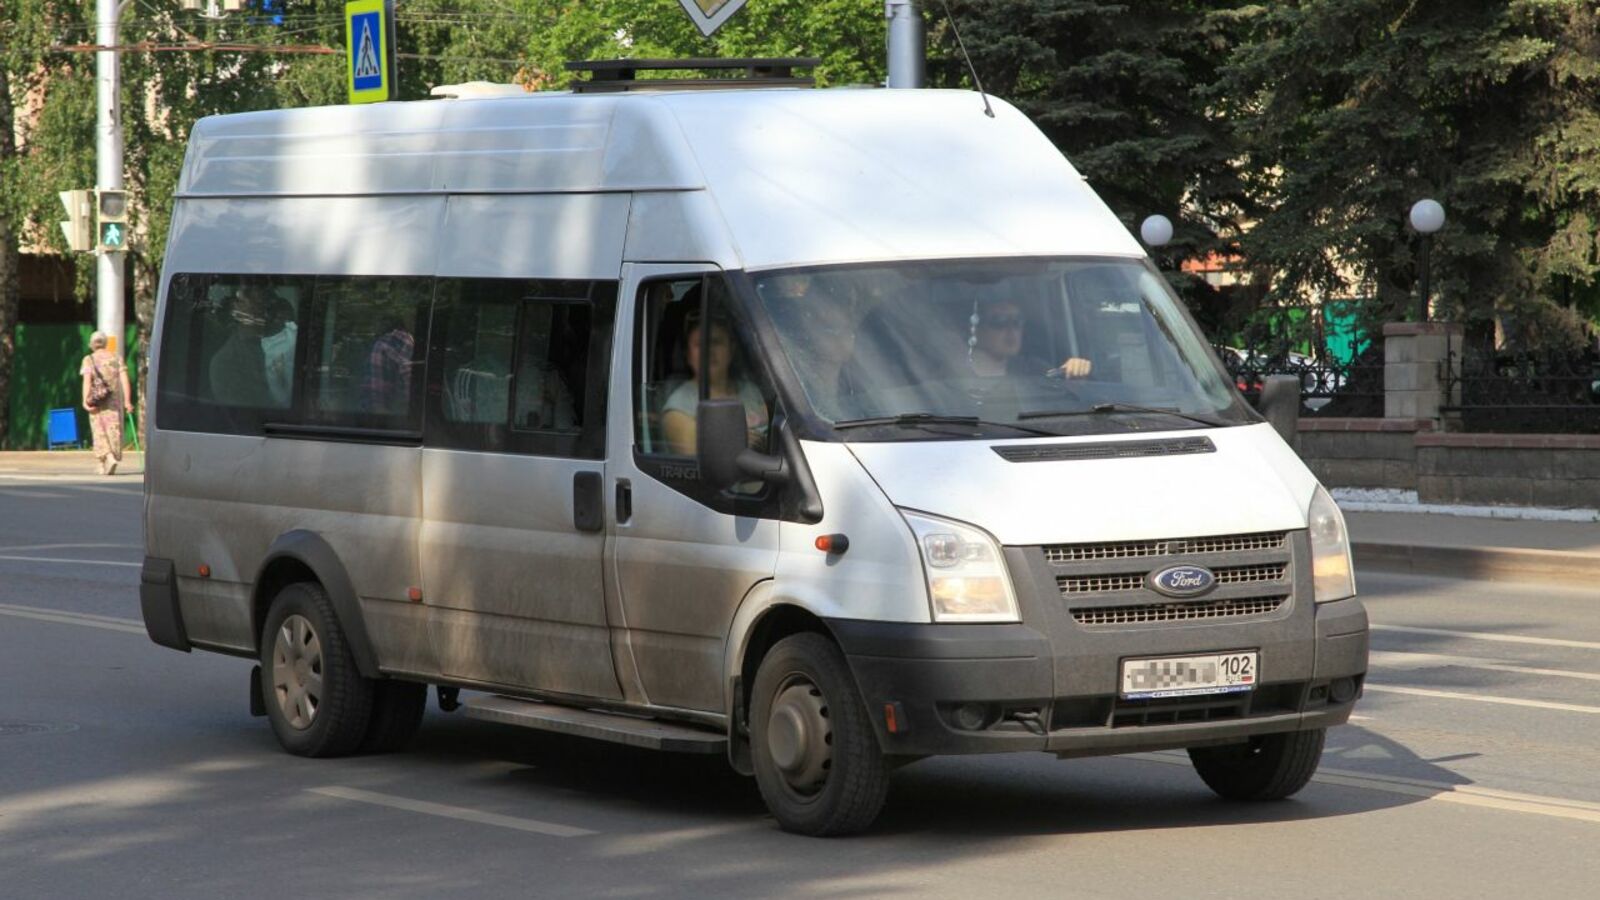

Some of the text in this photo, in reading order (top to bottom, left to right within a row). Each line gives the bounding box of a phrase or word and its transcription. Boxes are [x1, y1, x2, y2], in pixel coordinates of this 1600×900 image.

[660, 464, 701, 480] TRANSI
[1170, 571, 1202, 587] Ford
[1221, 656, 1250, 675] 102
